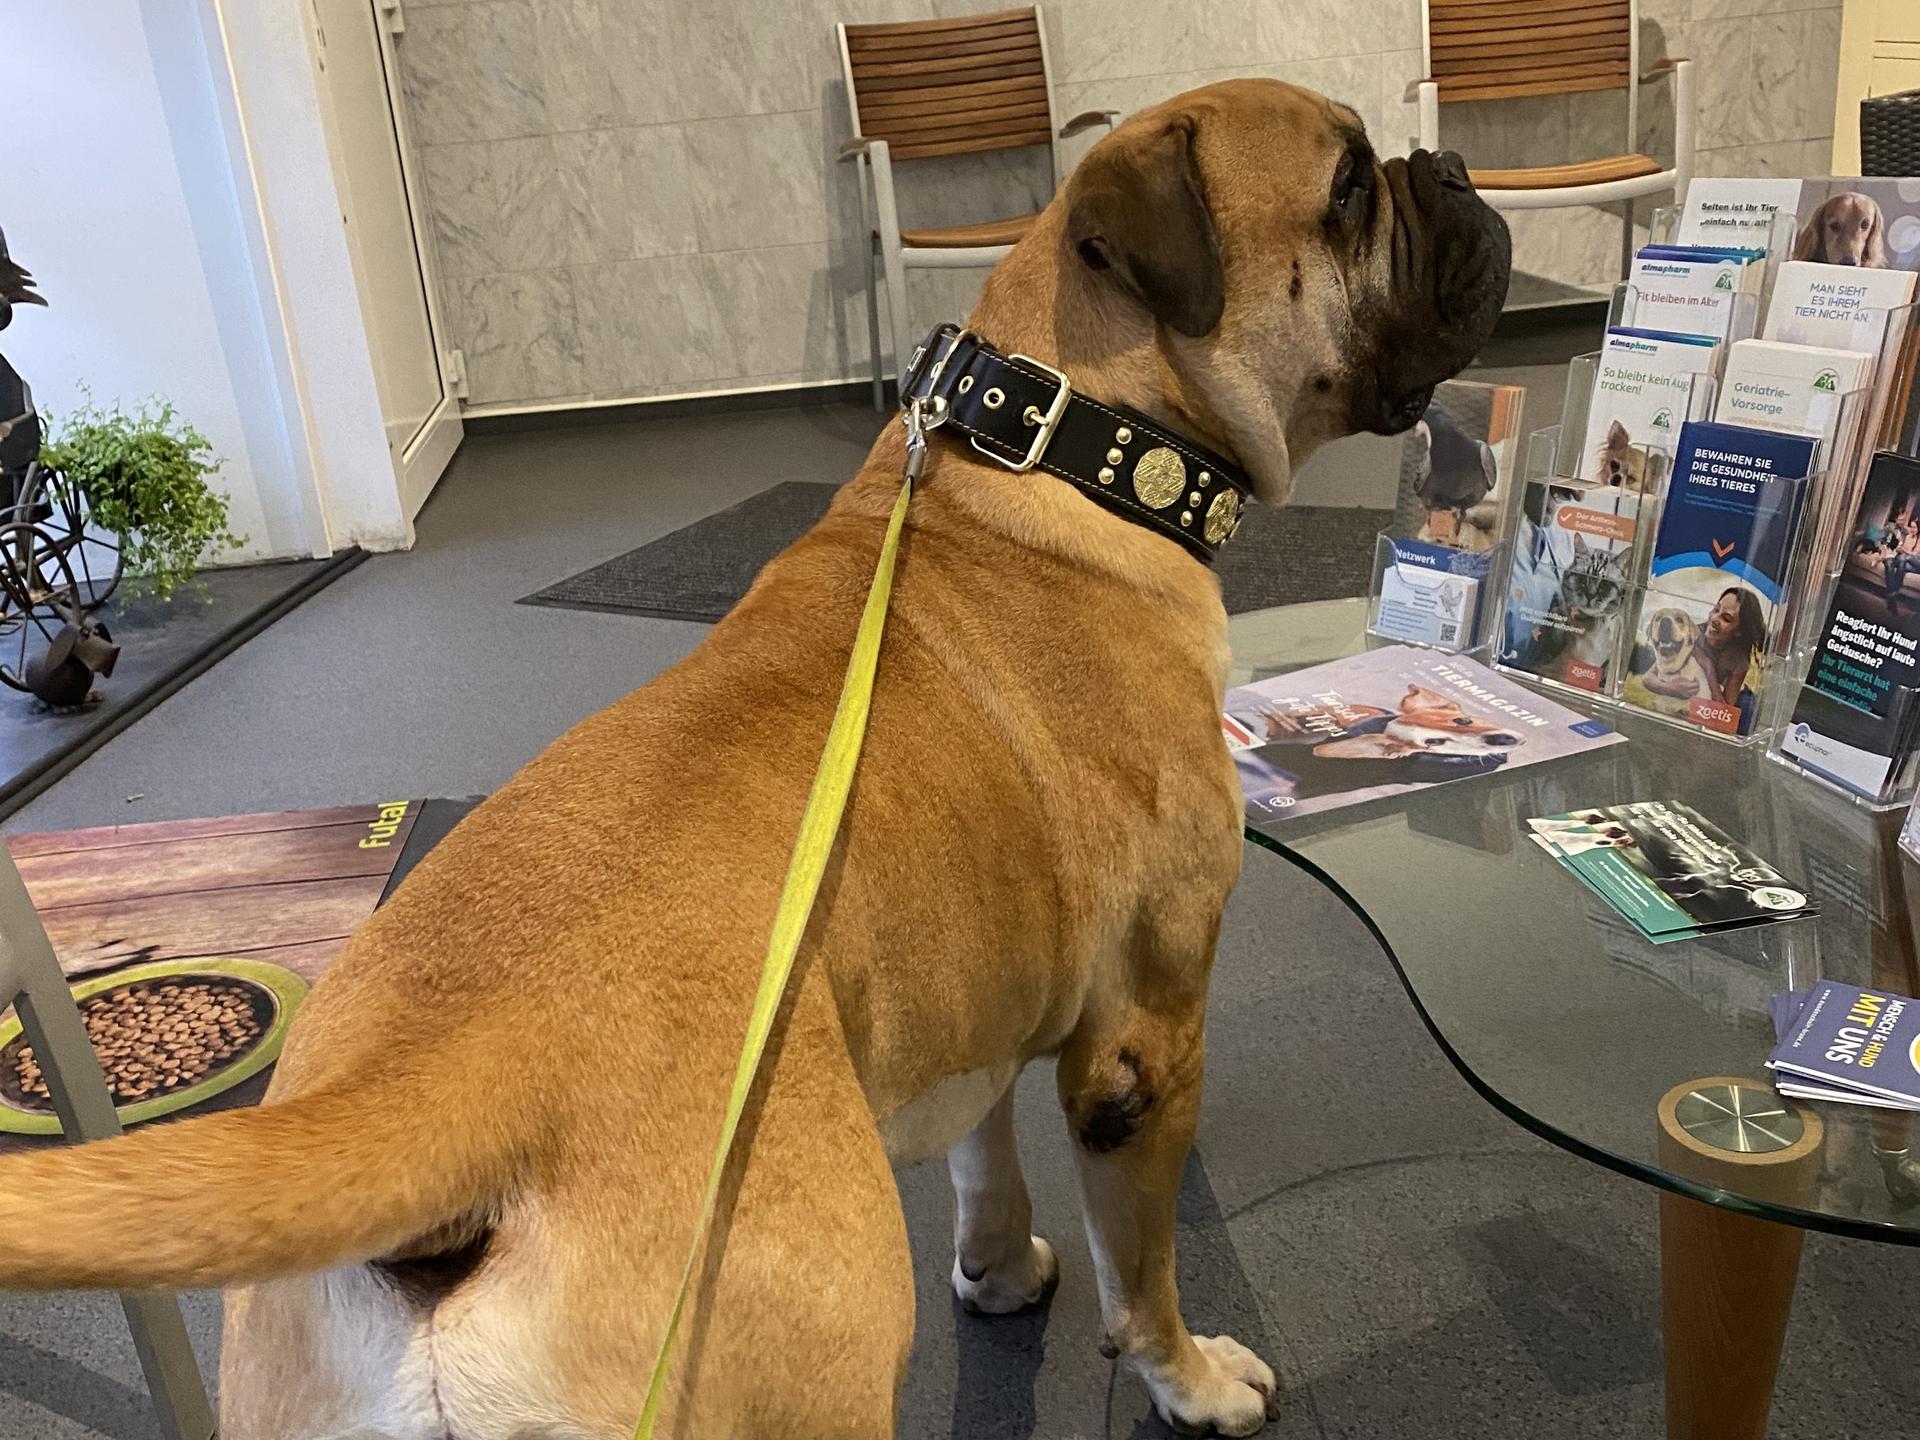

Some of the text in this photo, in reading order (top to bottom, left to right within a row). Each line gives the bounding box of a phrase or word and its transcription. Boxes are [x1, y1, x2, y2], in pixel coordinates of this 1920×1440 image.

[1701, 202, 1779, 212] Selten ist Ihr Tier
[1641, 264, 1691, 274] almapharm
[1638, 291, 1649, 301] Fit
[1650, 292, 1686, 305] bleiben
[1688, 296, 1699, 305] im
[1810, 283, 1868, 297] MAN SIEHT
[1811, 296, 1861, 309] ES IHREM
[1794, 306, 1869, 322] TIER NICHT AN
[1610, 338, 1658, 352] almapharm
[1600, 380, 1642, 395] trocken!
[1604, 366, 1690, 392] So bleibt kein Aug
[1734, 382, 1791, 398] Geriatrie-
[1731, 396, 1783, 415] Vorsorge
[1694, 448, 1773, 469] BEWAHREN SIE
[1692, 461, 1778, 483] DIE GESUNDHEIT
[1688, 474, 1756, 494] IHRES TIERES
[1836, 610, 1918, 651] Reagiert Ihr Hund
[1827, 638, 1883, 669] Geräusche?
[1831, 624, 1916, 667] ängstlich auf laute
[1572, 666, 1596, 680] zoetis
[1822, 654, 1891, 692] Ihr Tierarzt hat
[1818, 669, 1878, 701] eine einfache
[1432, 664, 1549, 727] TIERMAGAZIN
[1696, 705, 1733, 723] zoetis
[1305, 712, 1348, 737] Tipps
[1824, 993, 1887, 1065] MIT UNS
[1858, 999, 1907, 1068] MENSCH & HUND
